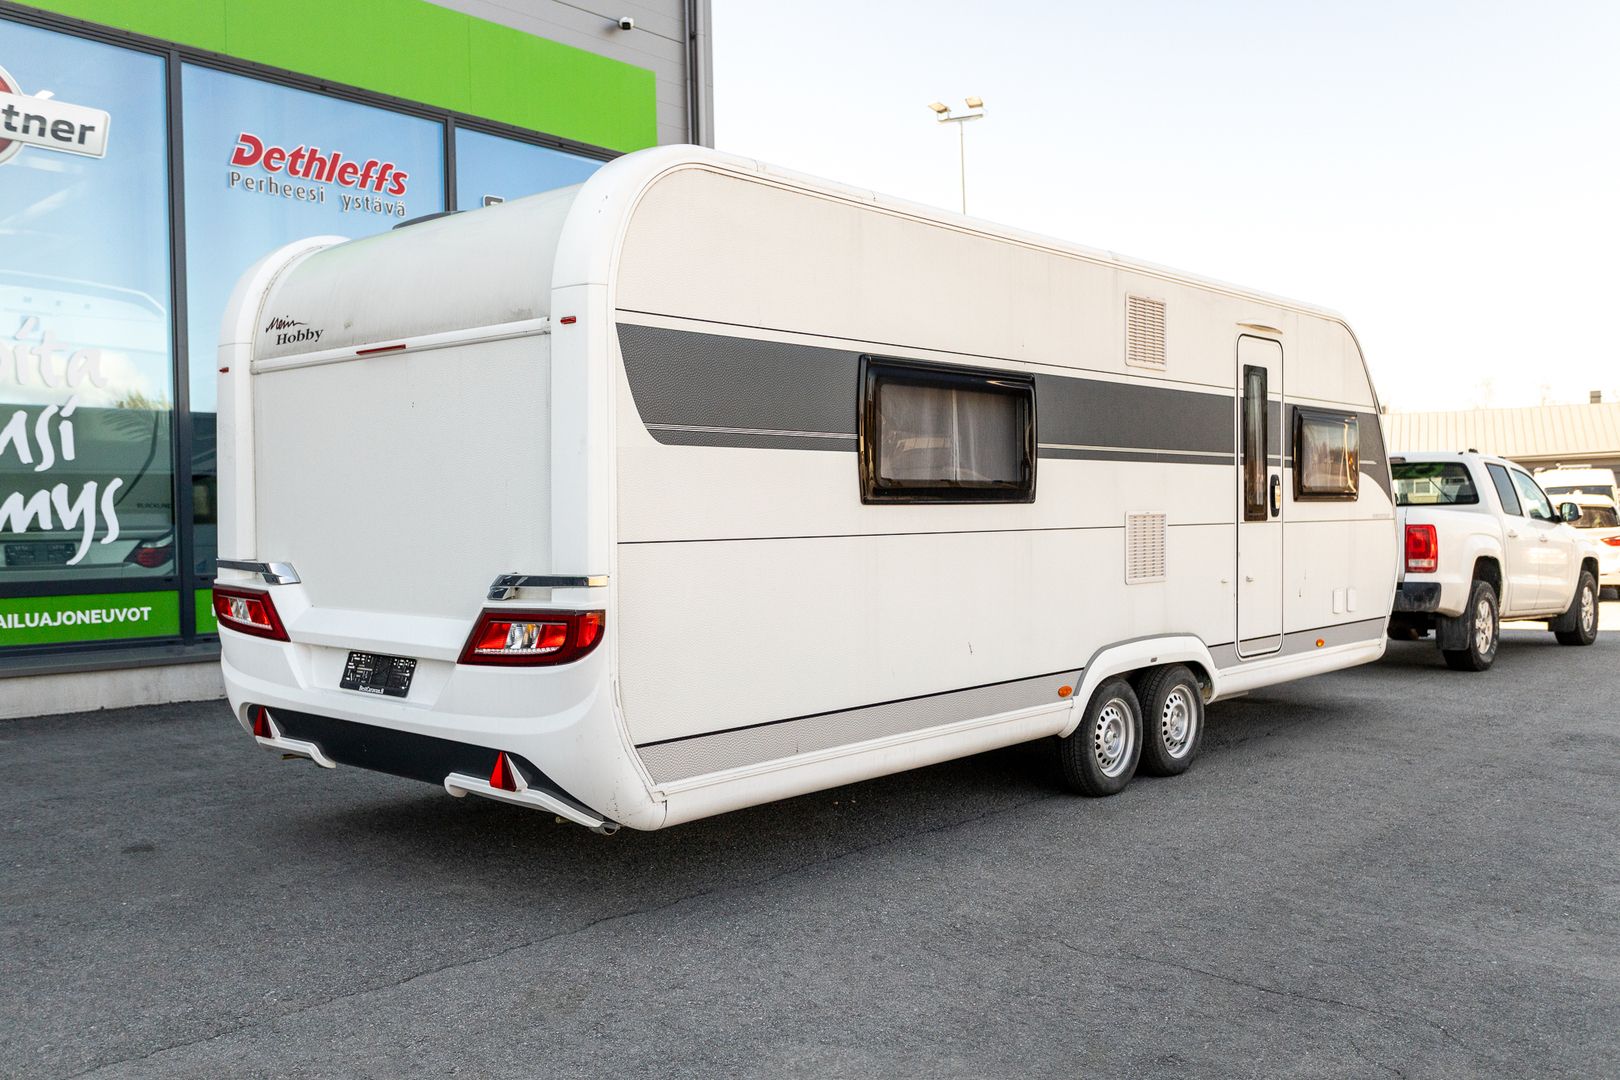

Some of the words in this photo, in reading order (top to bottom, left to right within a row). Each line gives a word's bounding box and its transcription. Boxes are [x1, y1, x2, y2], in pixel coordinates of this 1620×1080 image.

[231, 133, 408, 196] Dethleffs
[230, 171, 325, 202] Perheesi
[342, 194, 406, 217] ystävä
[276, 328, 323, 345] Hobby
